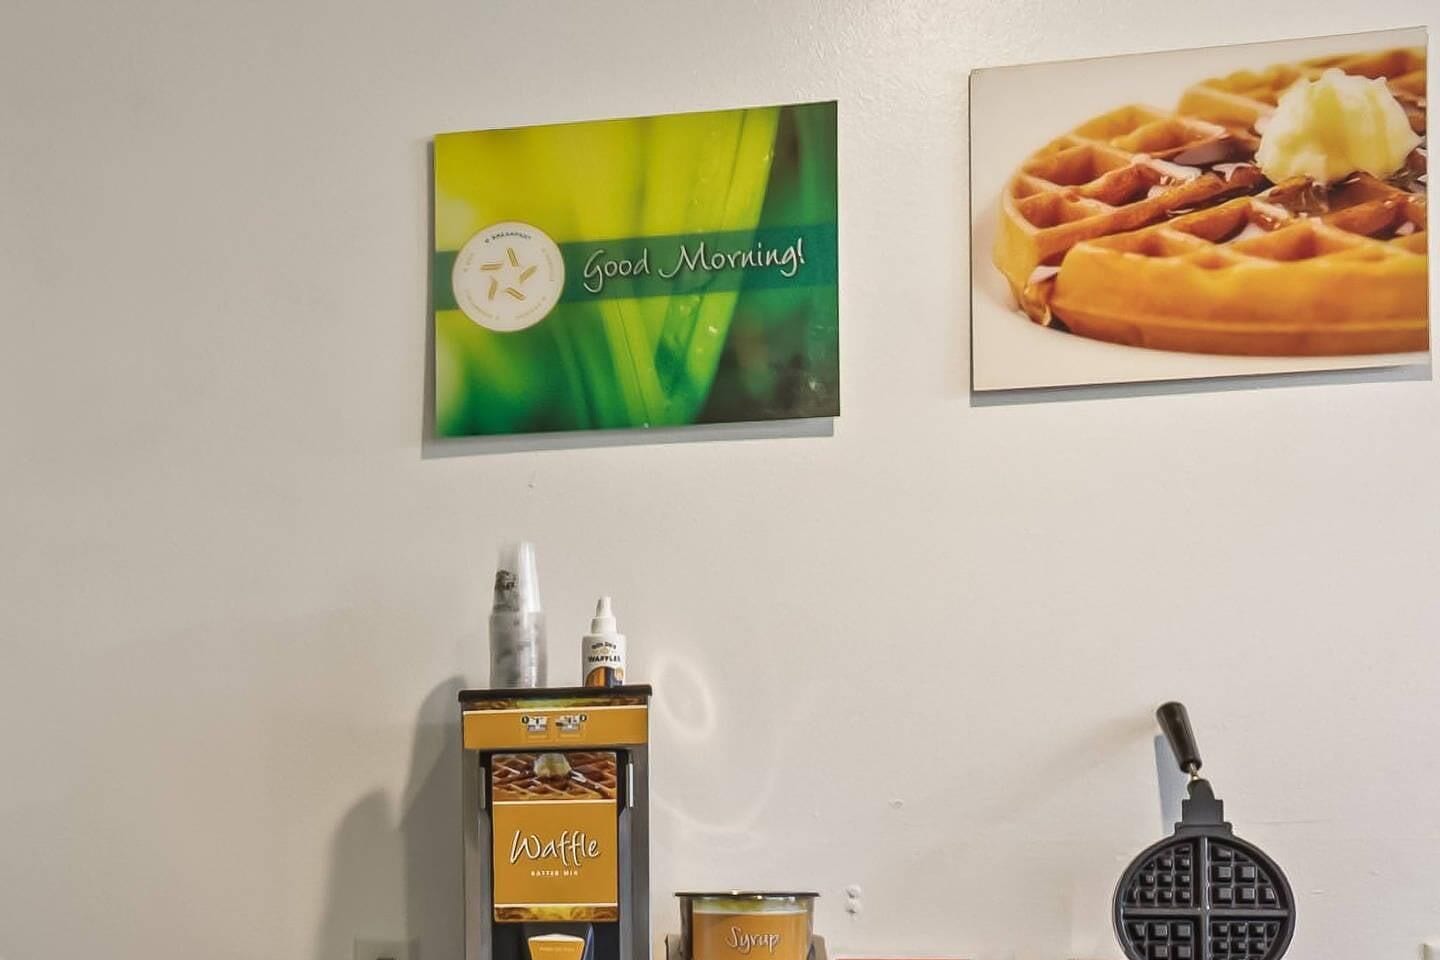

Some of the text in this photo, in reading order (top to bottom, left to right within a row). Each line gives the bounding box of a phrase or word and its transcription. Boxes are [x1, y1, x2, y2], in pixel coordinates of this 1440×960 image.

[583, 247, 651, 294] Good
[658, 237, 806, 279] Morning!
[509, 829, 601, 867] Waffle
[727, 926, 781, 954] Syrup
